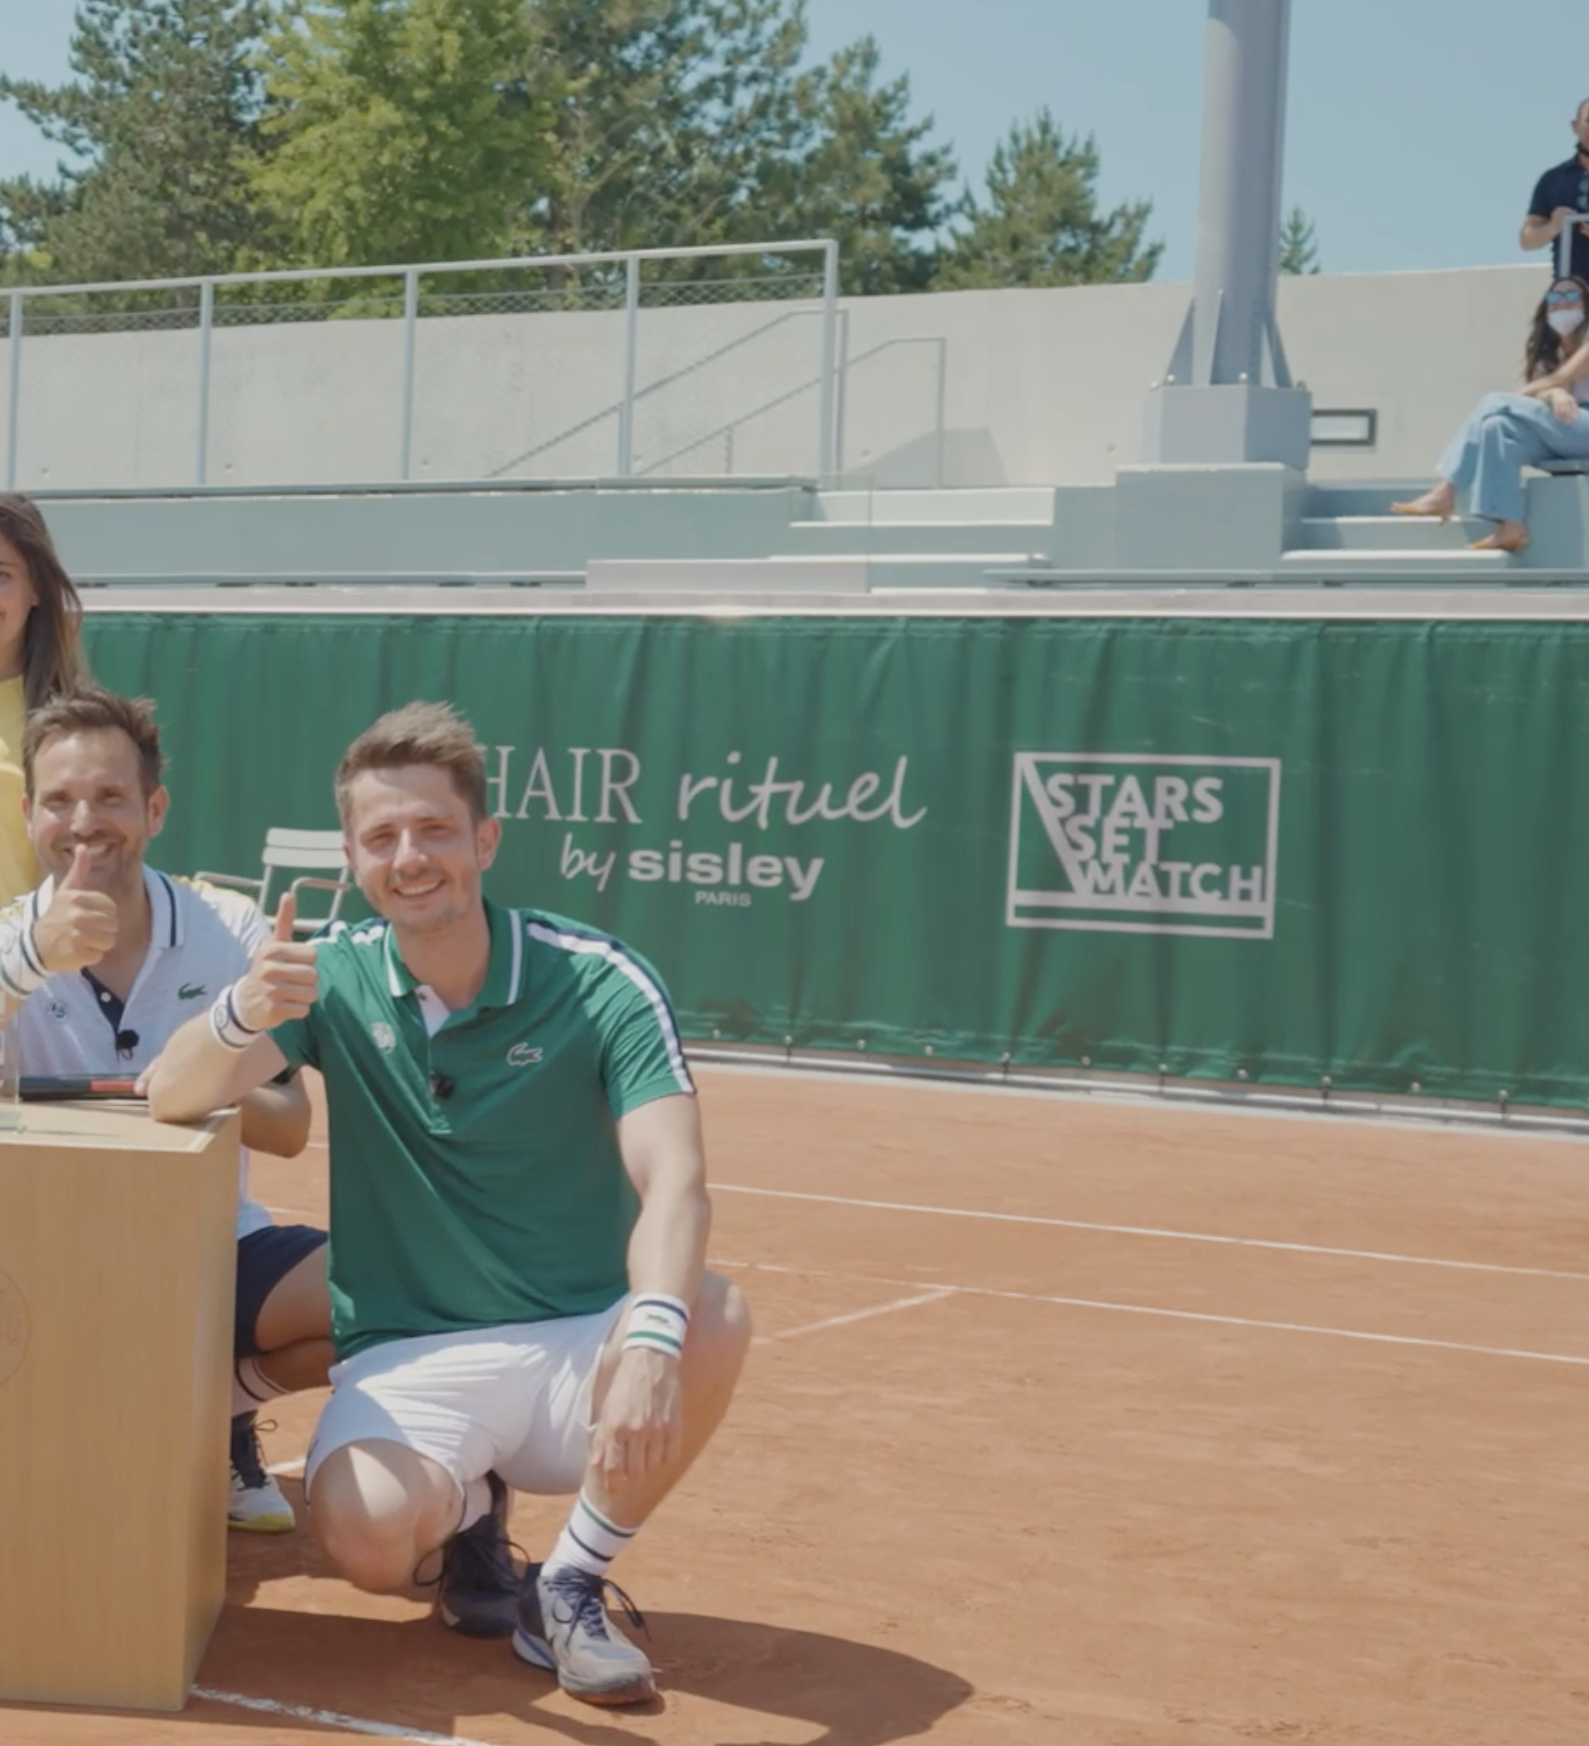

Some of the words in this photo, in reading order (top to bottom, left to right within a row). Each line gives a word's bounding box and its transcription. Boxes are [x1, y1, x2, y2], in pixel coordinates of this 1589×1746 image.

[474, 745, 643, 824] HAIR
[677, 751, 929, 831] rituel
[1045, 772, 1224, 823] STARS
[1064, 814, 1175, 866] SET
[559, 832, 616, 893] by
[627, 839, 825, 901] sisley
[1081, 858, 1264, 903] MATCH
[694, 890, 752, 908] PARIS
